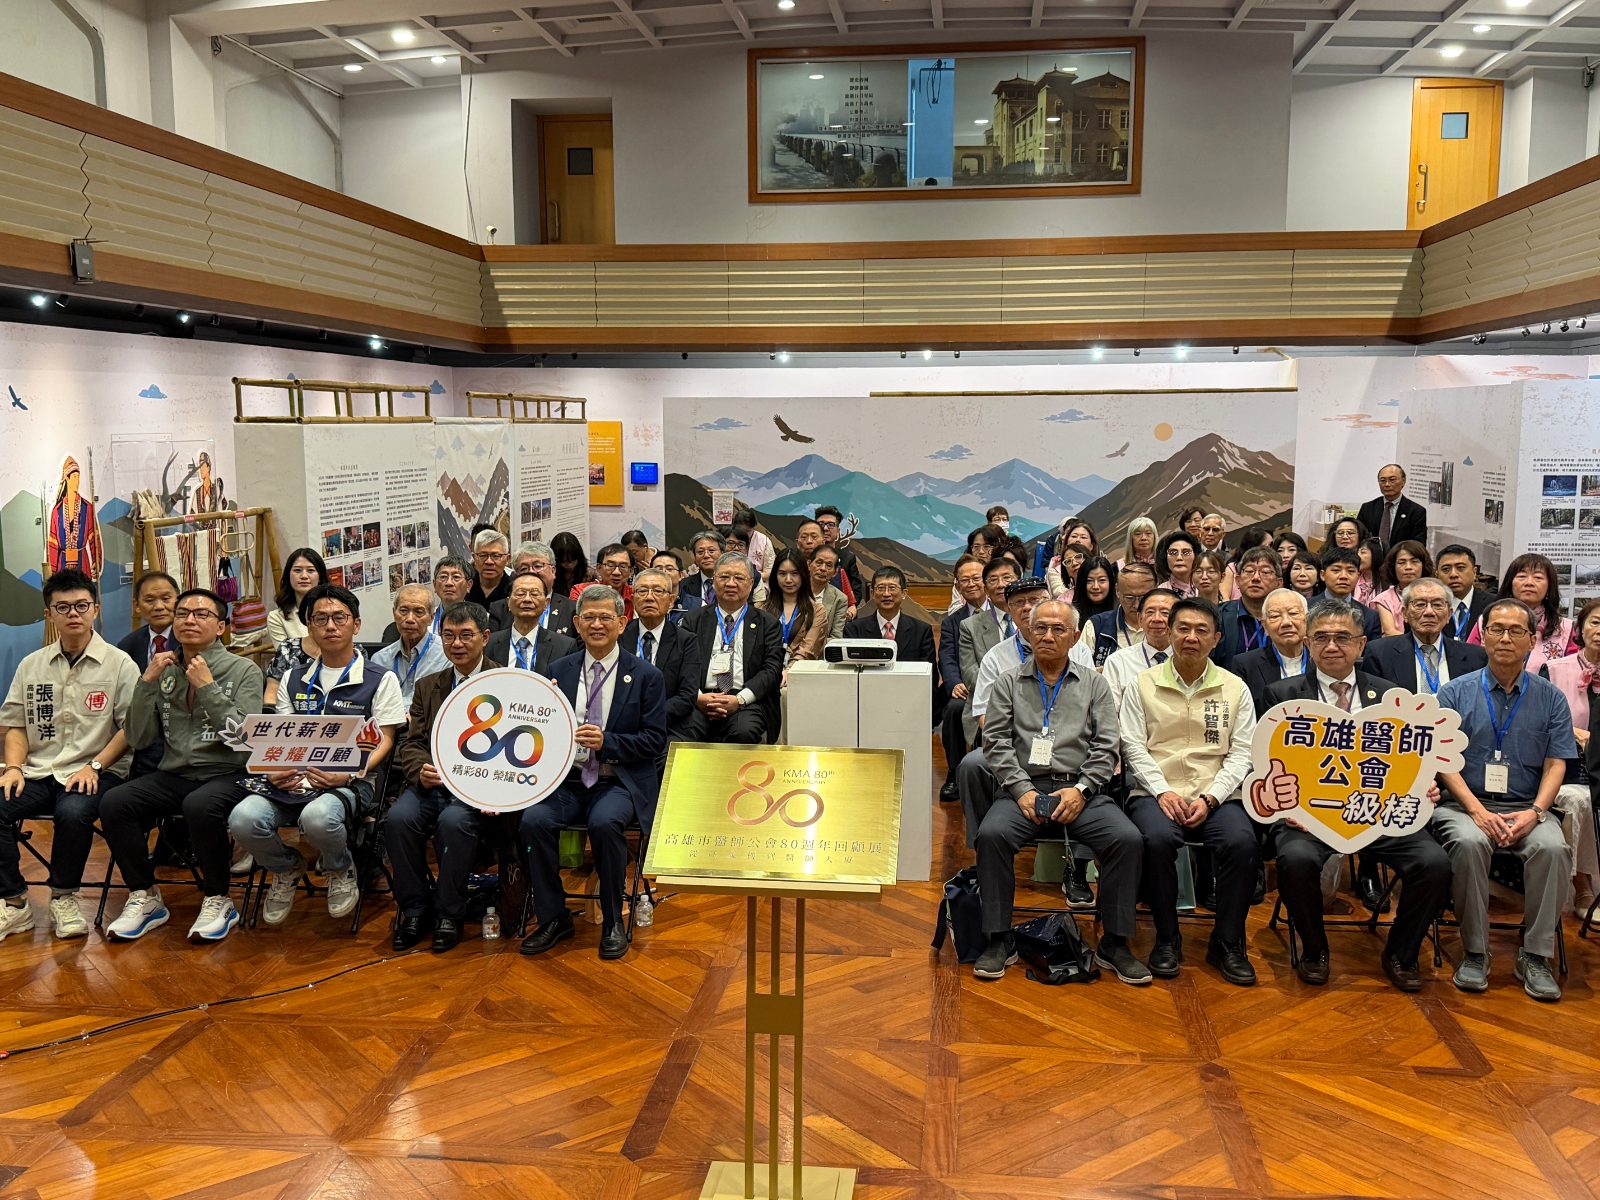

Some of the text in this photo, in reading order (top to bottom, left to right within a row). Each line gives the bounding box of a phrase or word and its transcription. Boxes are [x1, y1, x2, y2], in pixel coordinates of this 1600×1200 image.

[88, 691, 105, 711] 博
[333, 699, 352, 709] KMT
[509, 702, 535, 715] KMA
[36, 683, 56, 741] 張博洋
[507, 713, 550, 724] ANNIVERSARY
[1203, 698, 1220, 745] 許智傑
[1222, 699, 1230, 729] 立法委員
[252, 721, 343, 739] 世代薪傳
[1284, 714, 1436, 757] 高雄醫師
[262, 746, 354, 763] 榮耀回顧
[452, 764, 489, 779] 精彩80
[783, 768, 811, 779] KMA
[1318, 754, 1391, 790] 公會
[1309, 790, 1420, 828] 一級棒
